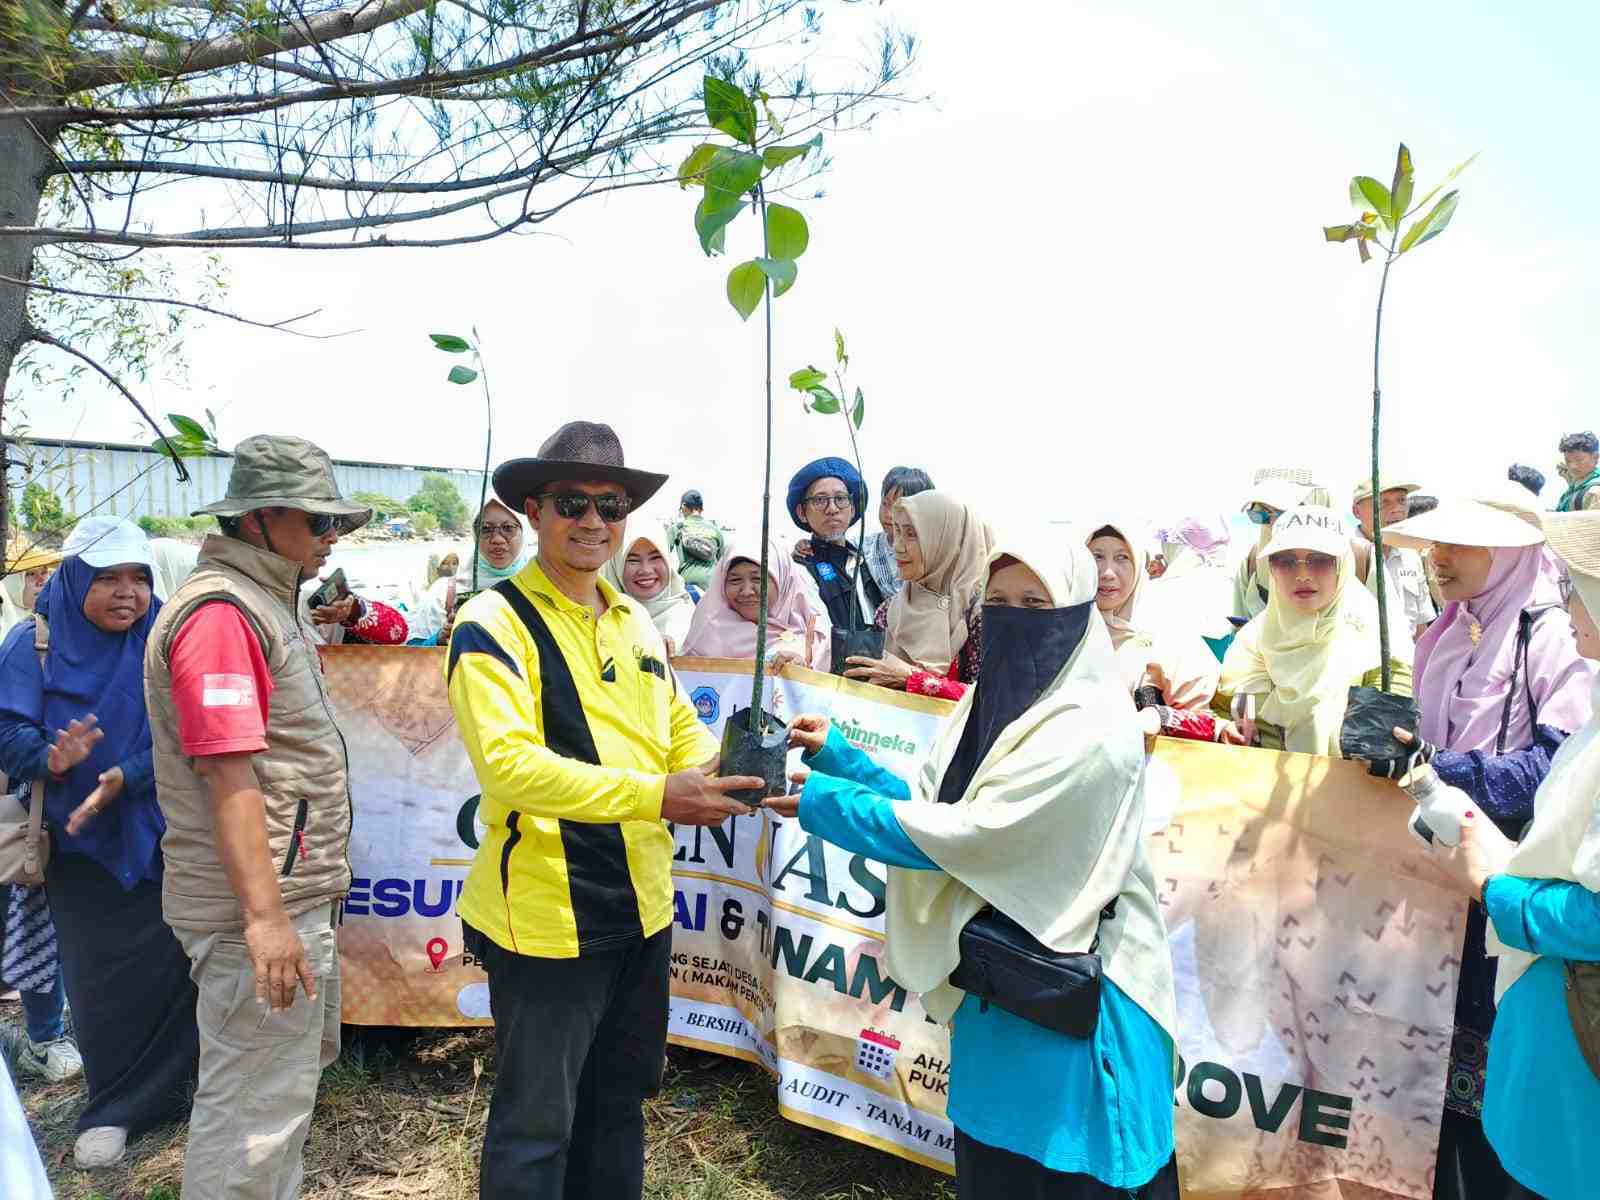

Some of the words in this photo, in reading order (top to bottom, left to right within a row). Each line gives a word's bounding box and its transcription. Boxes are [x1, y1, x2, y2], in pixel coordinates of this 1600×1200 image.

[343, 878, 464, 918] ESU
[720, 898, 745, 941] &
[691, 956, 733, 977] SEJATI
[686, 1012, 744, 1036] BERSIH
[785, 1078, 850, 1108] AUDIT
[866, 1103, 932, 1142] TANAM
[933, 1133, 956, 1152] M
